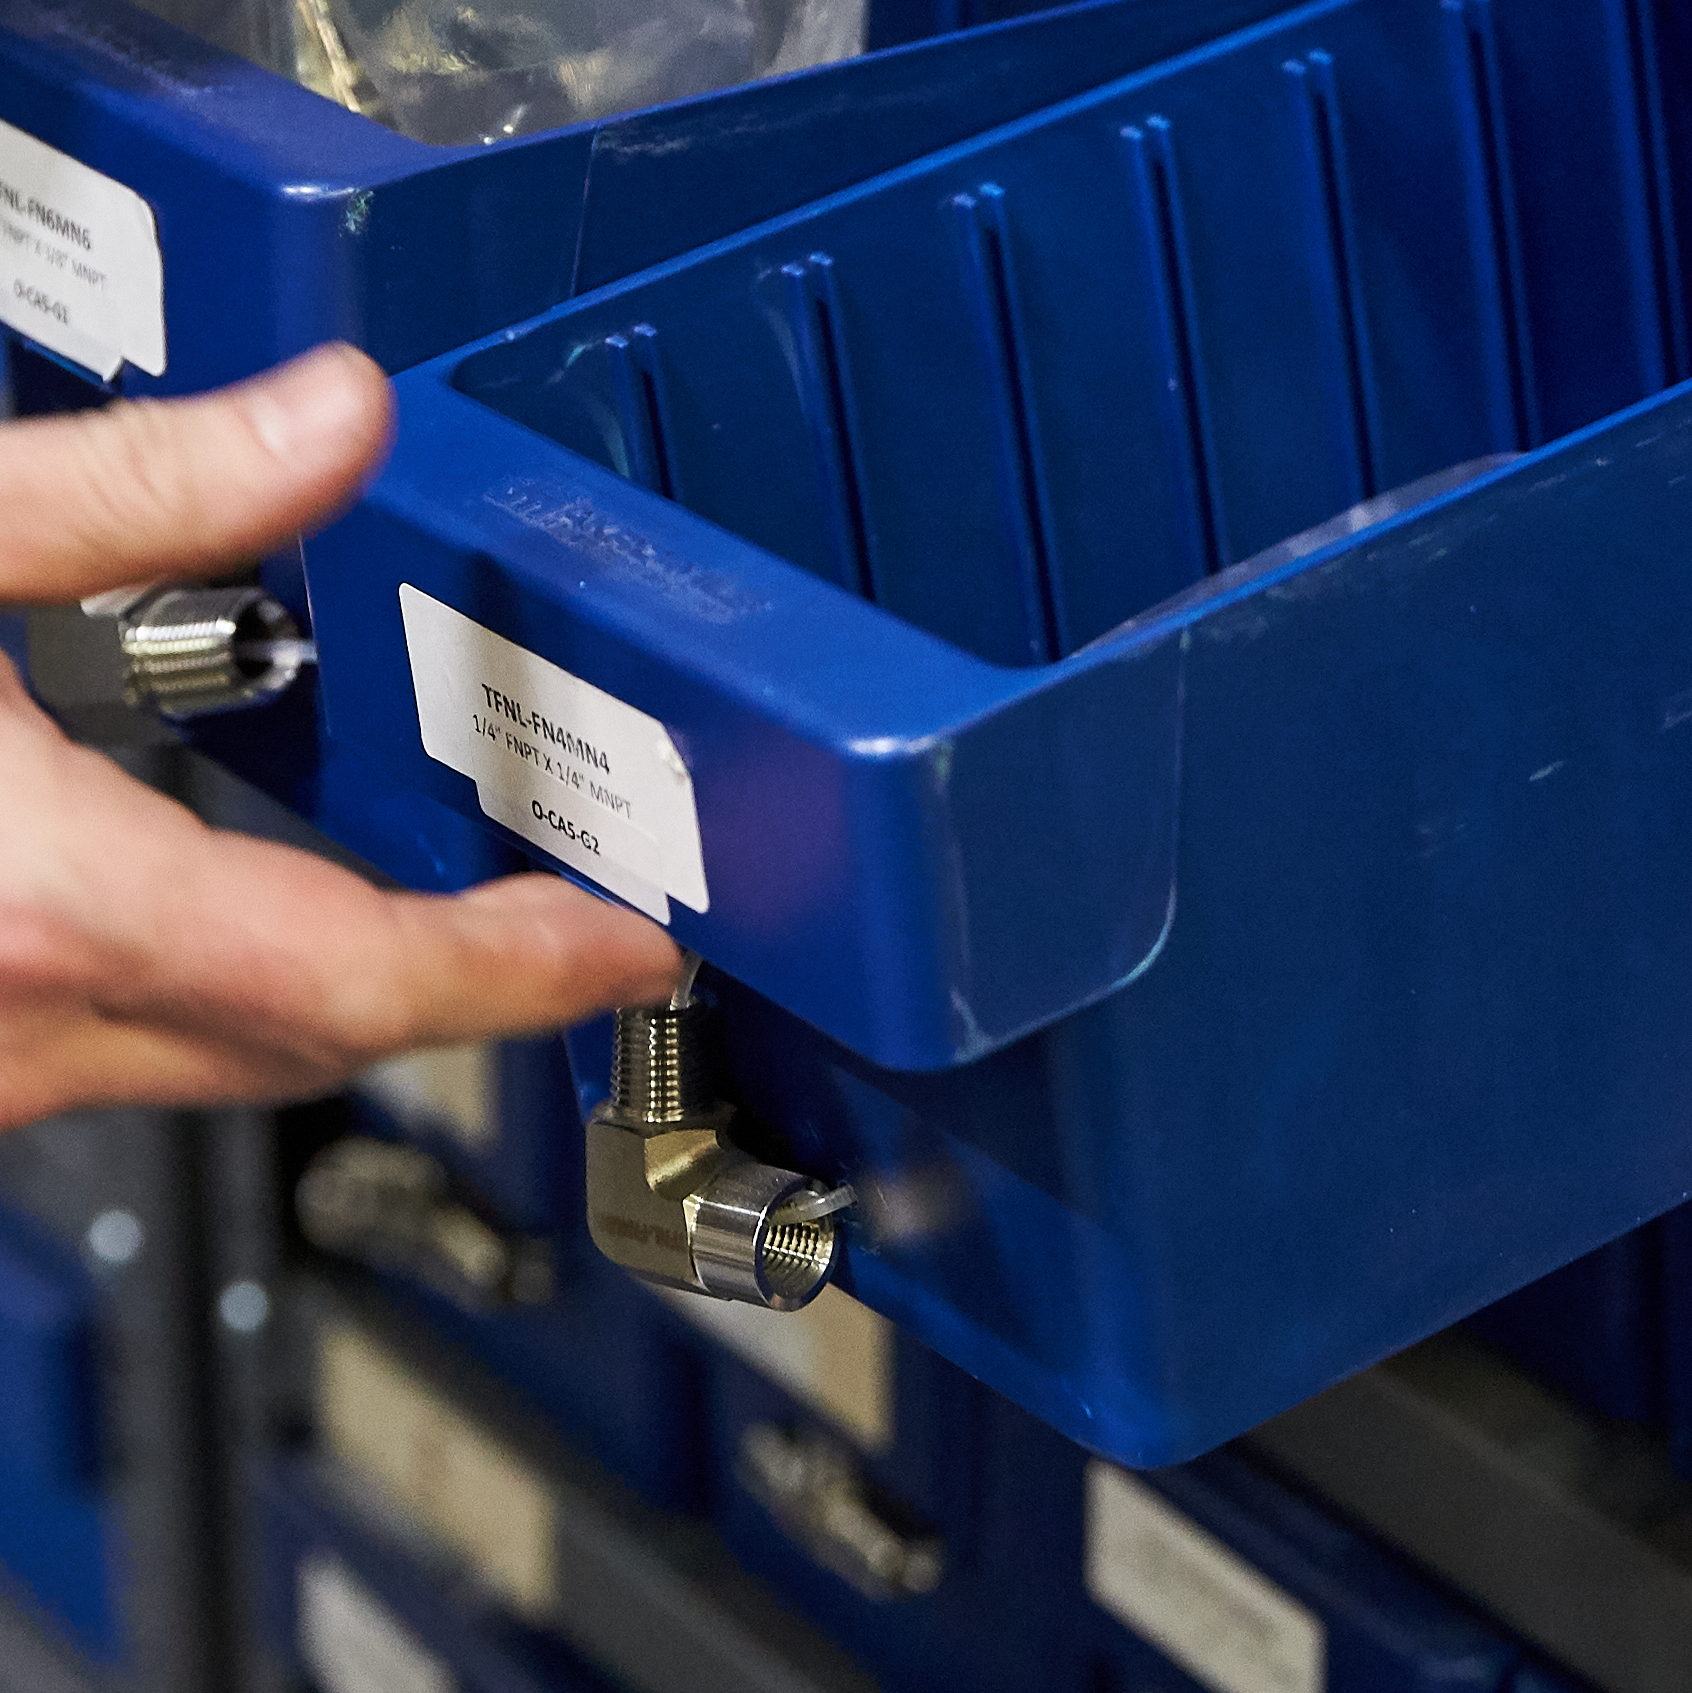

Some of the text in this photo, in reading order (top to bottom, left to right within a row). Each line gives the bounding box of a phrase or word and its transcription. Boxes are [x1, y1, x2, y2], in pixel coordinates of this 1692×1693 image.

[473, 714, 631, 819] 1/4" FNPT X 1/4" MNPT
[481, 683, 610, 775] TFNL-FN4MN4
[532, 800, 601, 856] O-CA5-G2
